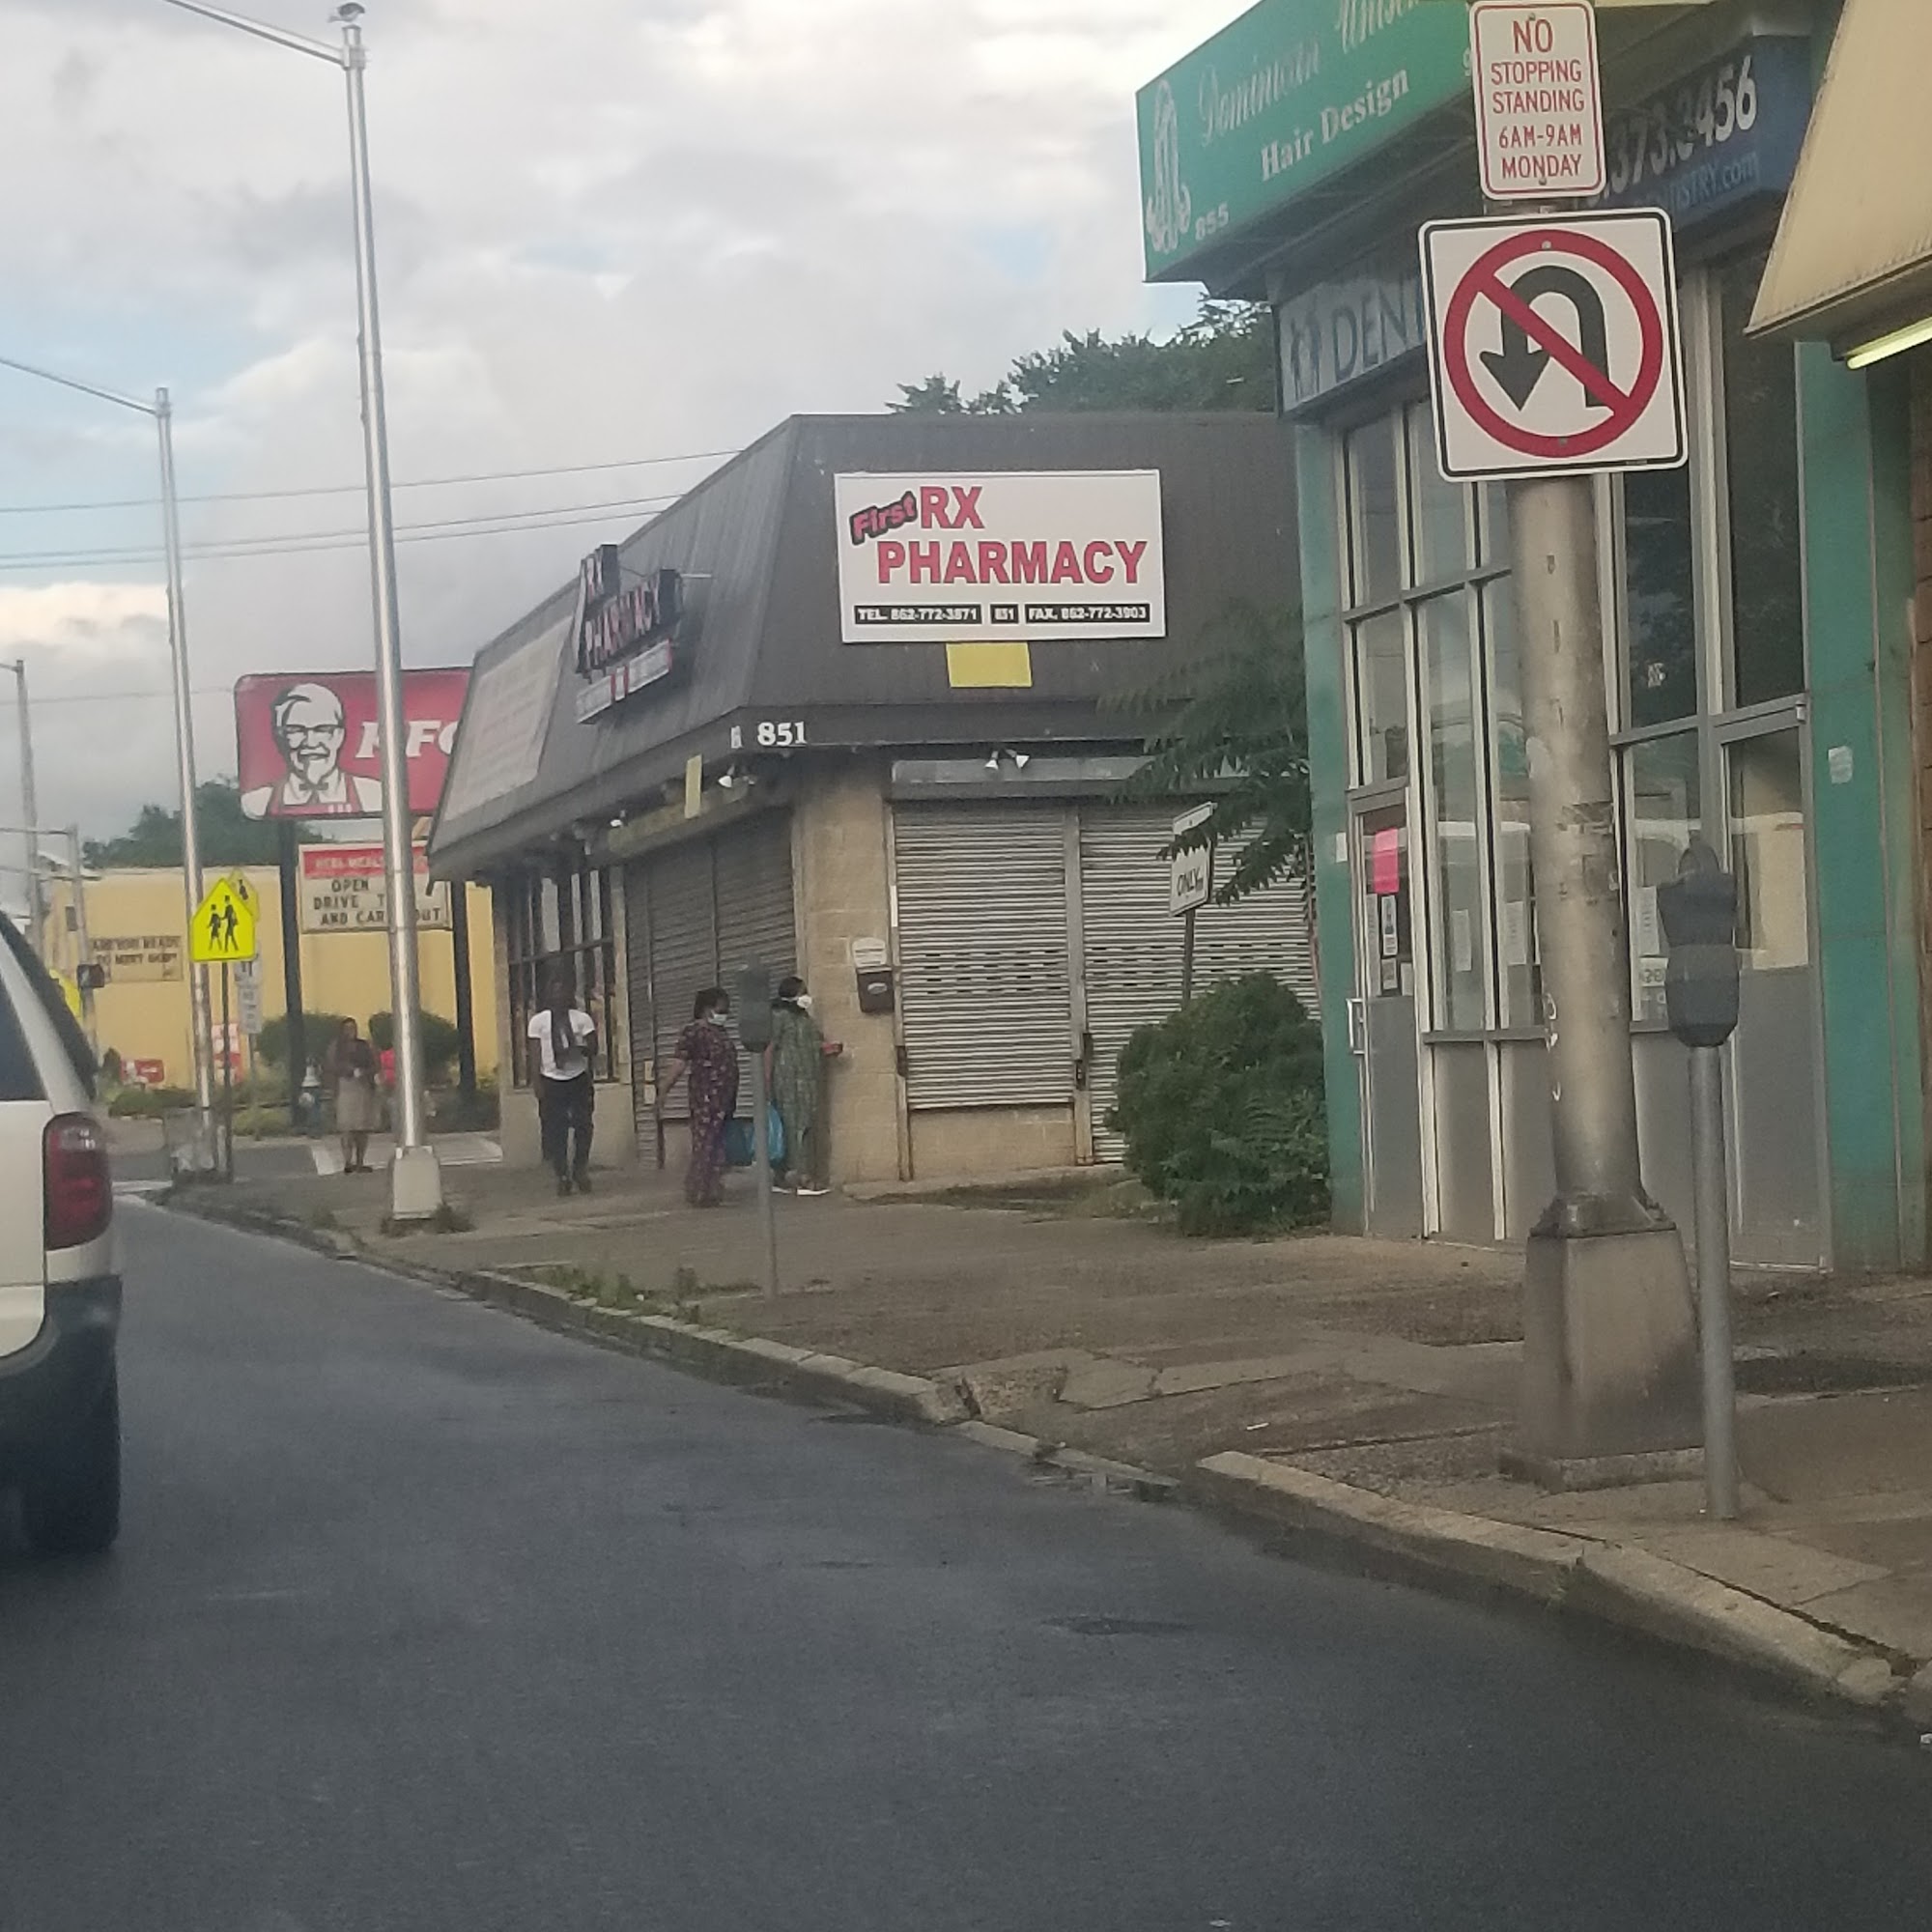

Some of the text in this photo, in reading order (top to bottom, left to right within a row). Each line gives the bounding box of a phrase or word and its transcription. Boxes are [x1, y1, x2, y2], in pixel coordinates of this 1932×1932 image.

[1513, 19, 1553, 54] NO
[1491, 59, 1582, 85] STOPPING
[1492, 89, 1585, 114] STANDING
[1261, 70, 1409, 182] Hair Design
[1499, 124, 1583, 149] 6AM-9AM
[1502, 154, 1582, 179] MONDAY
[1195, 202, 1230, 241] 855
[849, 486, 985, 545] First RX
[877, 541, 1148, 584] PHARMACY
[756, 721, 808, 747] 851
[331, 878, 369, 893] OPEN
[313, 895, 359, 910] DRIVE
[321, 912, 349, 925] AND
